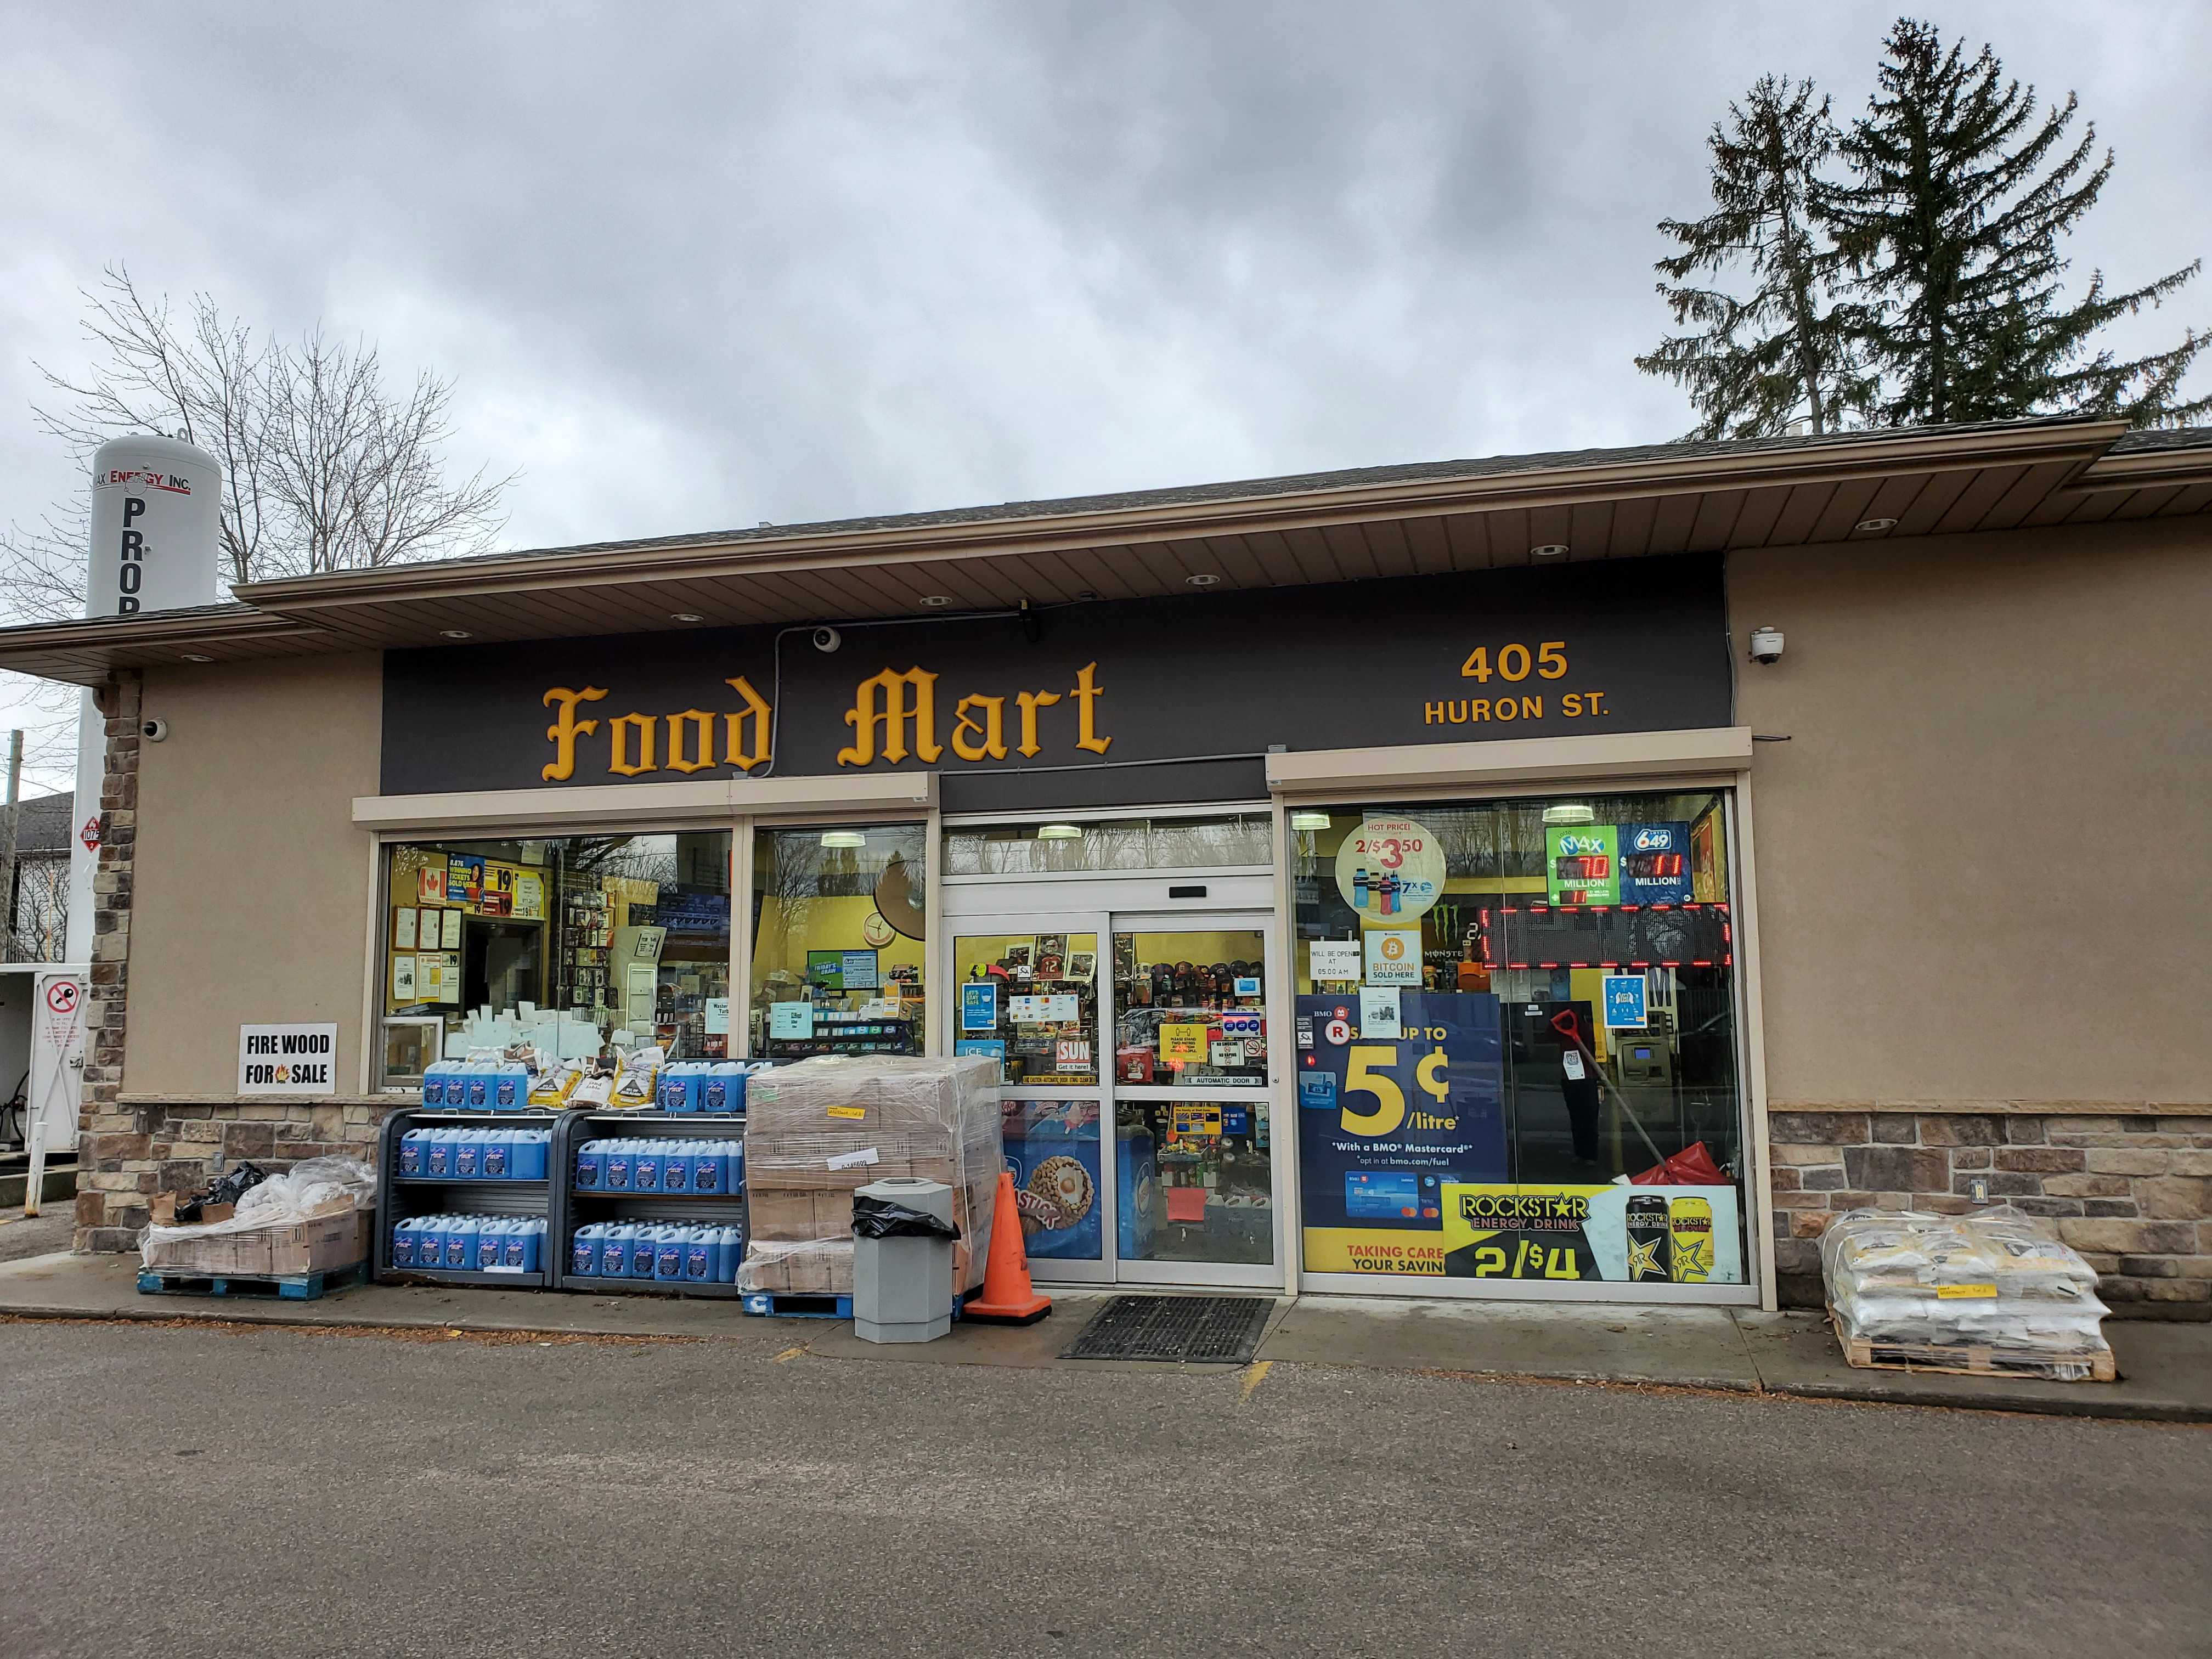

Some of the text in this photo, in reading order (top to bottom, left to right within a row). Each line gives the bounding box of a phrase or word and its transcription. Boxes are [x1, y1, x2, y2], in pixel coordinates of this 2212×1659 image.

[94, 473, 106, 485] AX
[169, 475, 191, 491] INC.
[1461, 641, 1568, 684] 405
[1425, 692, 1610, 725] HURON ST.
[541, 661, 1113, 782] Food Mart
[84, 830, 100, 839] 1075
[1560, 836, 1604, 855] MAX
[1579, 856, 1608, 877] 70
[498, 869, 511, 891] 19
[1564, 879, 1605, 888] MILLION
[1635, 877, 1677, 886] MILLION
[474, 905, 481, 914] 19
[523, 907, 528, 917] 19
[1424, 949, 1464, 958] MONSTE
[450, 955, 457, 966] 19
[1045, 960, 1057, 972] 12
[1373, 963, 1414, 971] BITCOIN
[1332, 1026, 1344, 1038] R
[1424, 1027, 1447, 1040] TO
[247, 1034, 330, 1054] FIRE WOOD
[966, 1047, 982, 1056] ICE
[1060, 1041, 1090, 1060] SUN
[246, 1064, 328, 1084] FOR SALE
[1390, 1156, 1449, 1166] bmo.com/fuel
[1473, 1217, 1578, 1229] ENERGY DRINK
[1347, 1245, 1444, 1259] TAKING CARE
[1352, 1258, 1445, 1273] YOUR SAVIN
